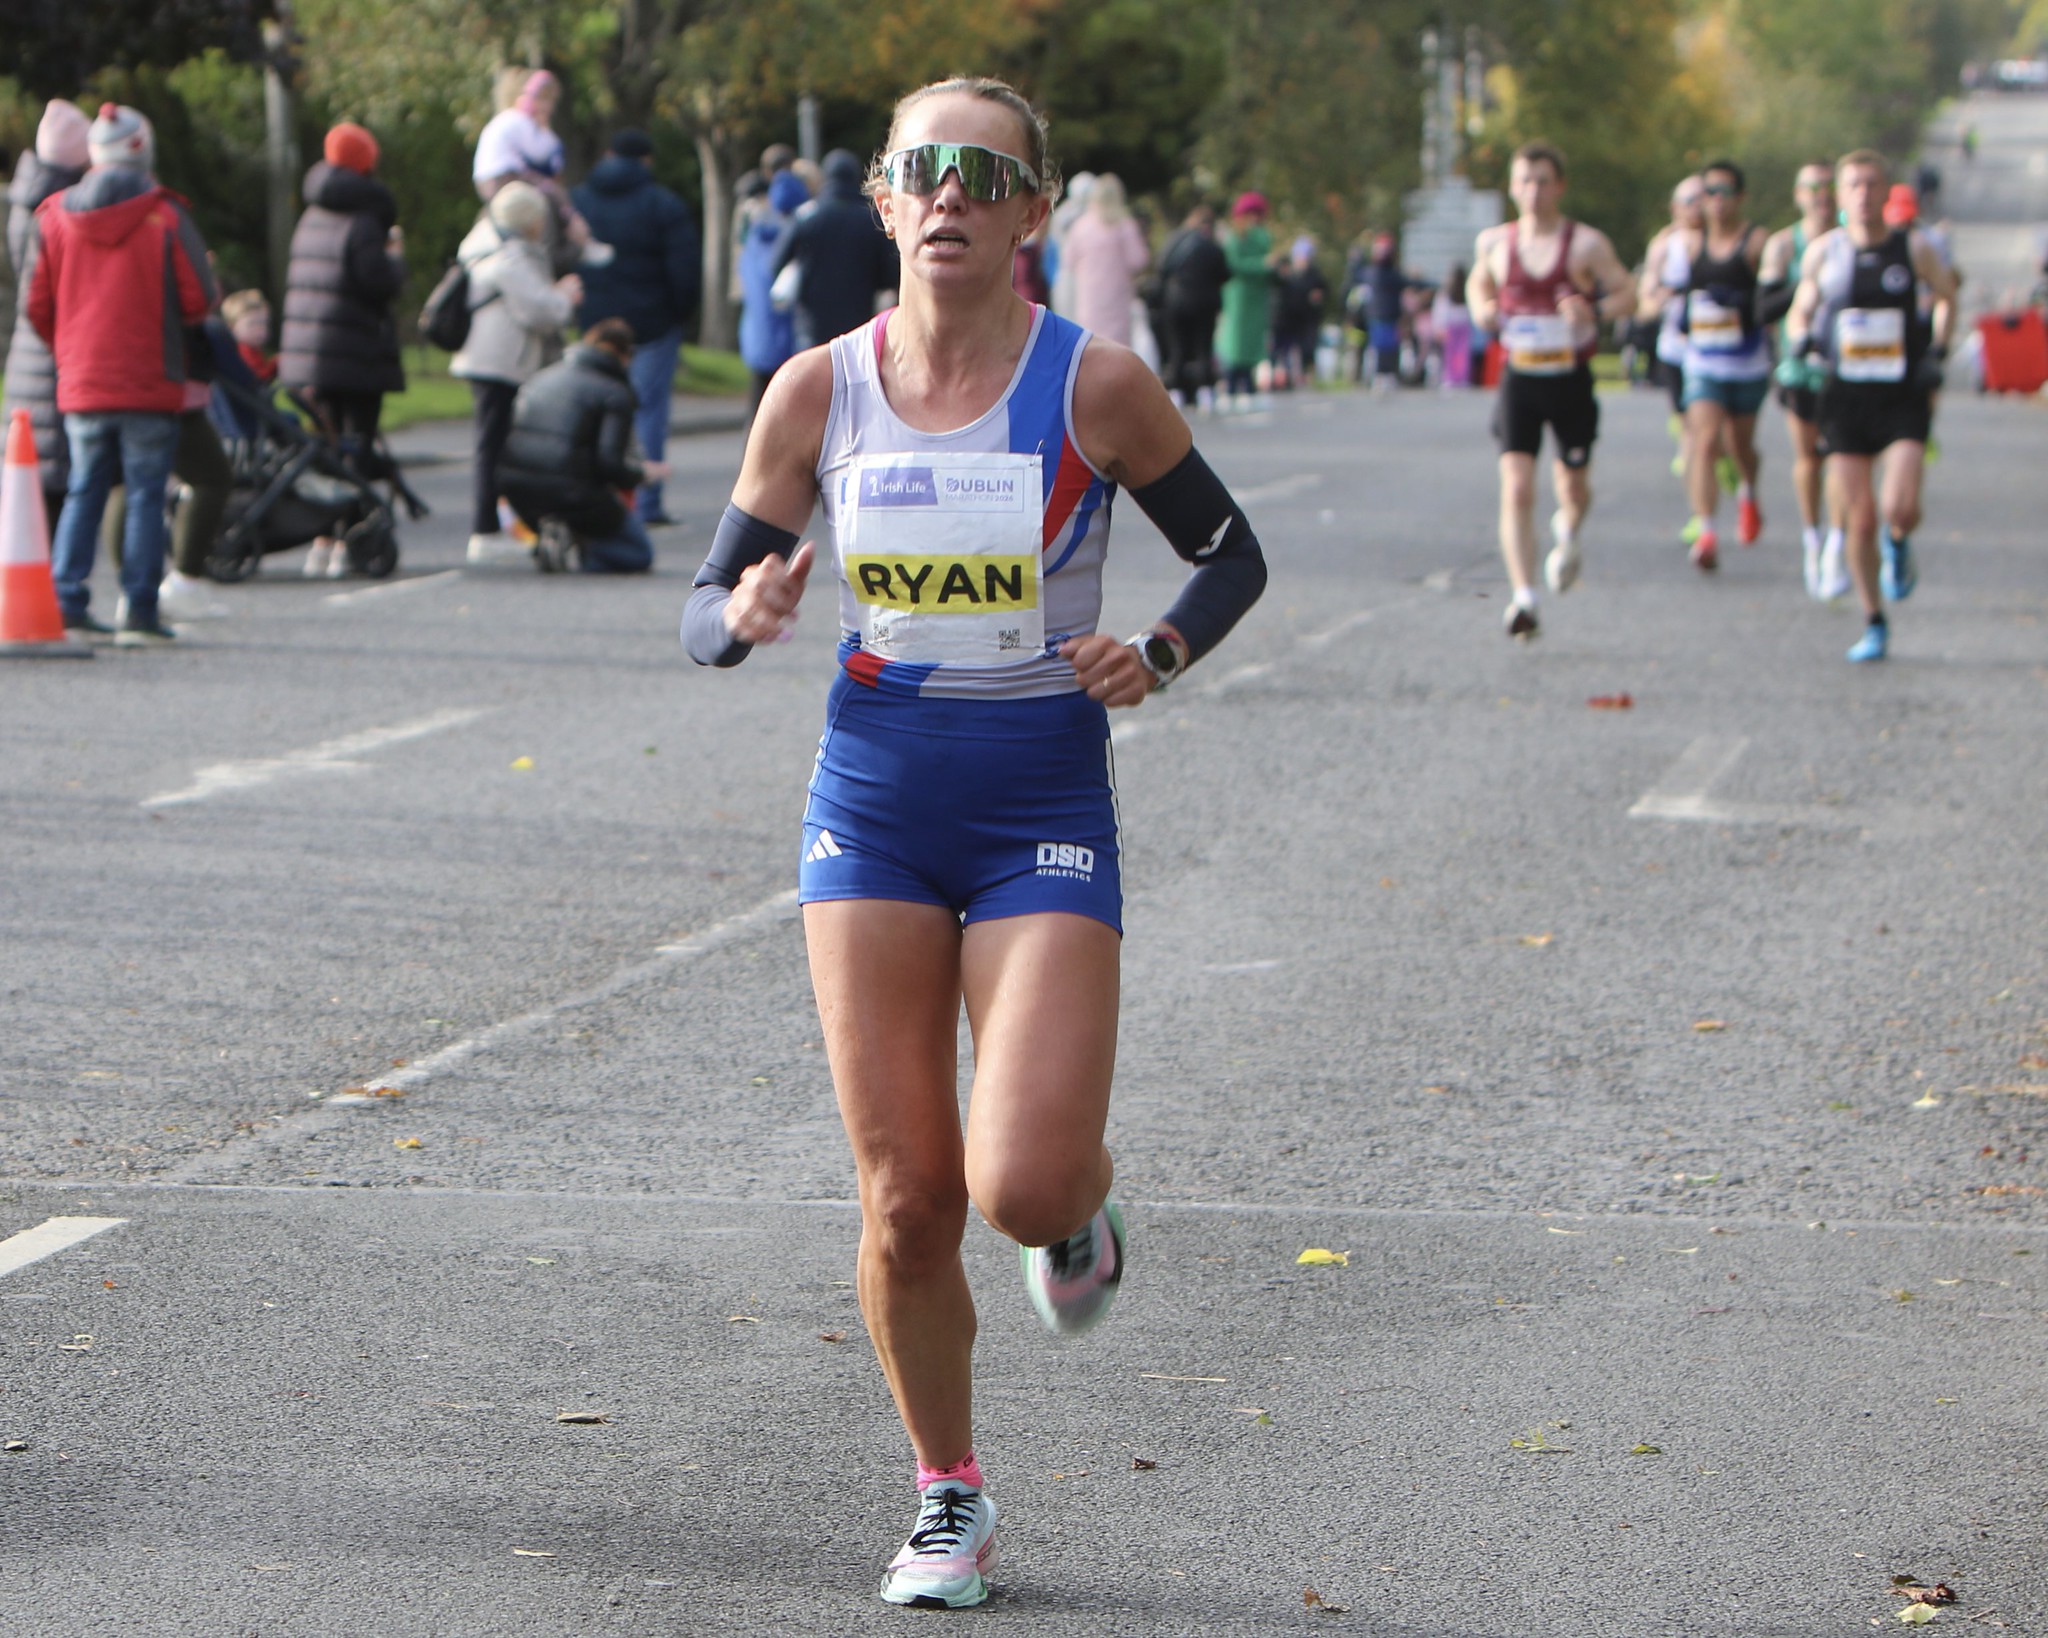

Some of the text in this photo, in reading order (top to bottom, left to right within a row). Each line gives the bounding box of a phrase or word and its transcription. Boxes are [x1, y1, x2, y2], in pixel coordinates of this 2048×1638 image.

[881, 481, 926, 493] Irish Life
[946, 478, 1014, 493] DUBLIN
[858, 563, 1022, 604] RYAN
[1037, 843, 1094, 873] DSD
[1036, 867, 1091, 883] ATHLETICS
